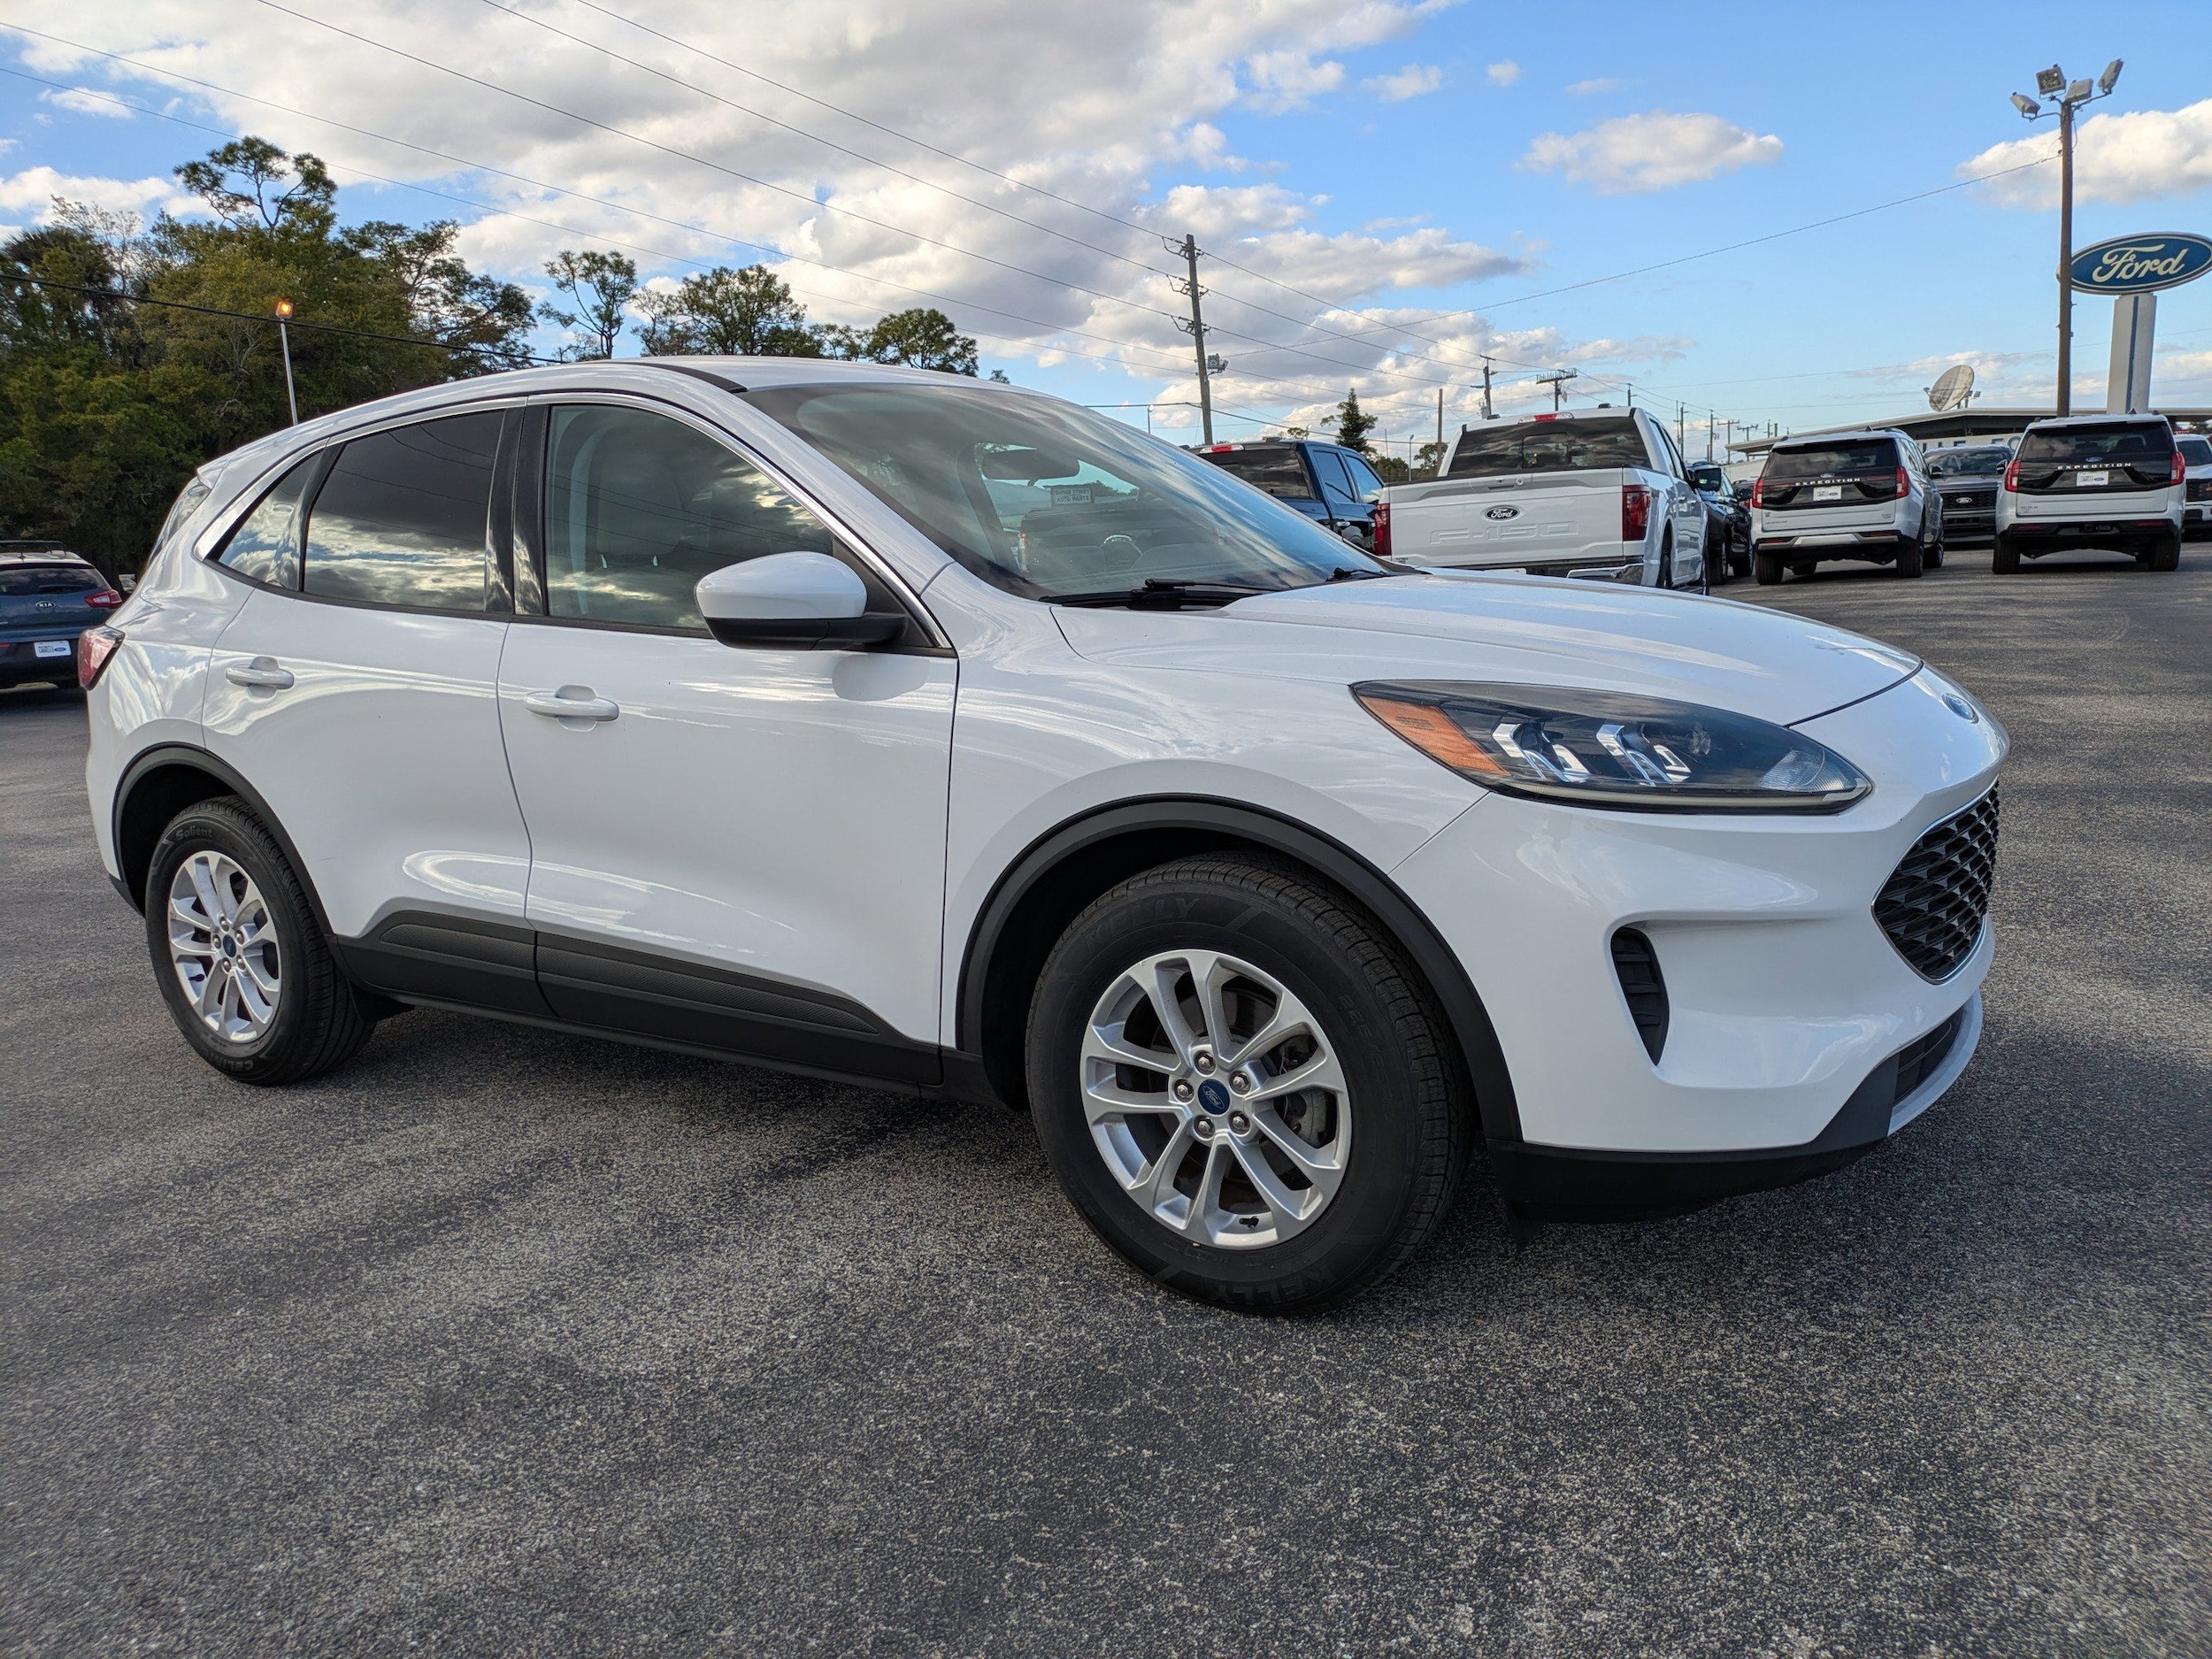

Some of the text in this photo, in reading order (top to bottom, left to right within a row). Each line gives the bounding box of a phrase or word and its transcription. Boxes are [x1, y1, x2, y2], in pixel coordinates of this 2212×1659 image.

[2092, 243, 2189, 283] Ford
[1795, 478, 1861, 487] EXPEDITION
[1491, 508, 1513, 518] Ford
[1430, 520, 1579, 545] F-150
[175, 825, 212, 841] Salient
[1205, 1089, 1222, 1106] Ford
